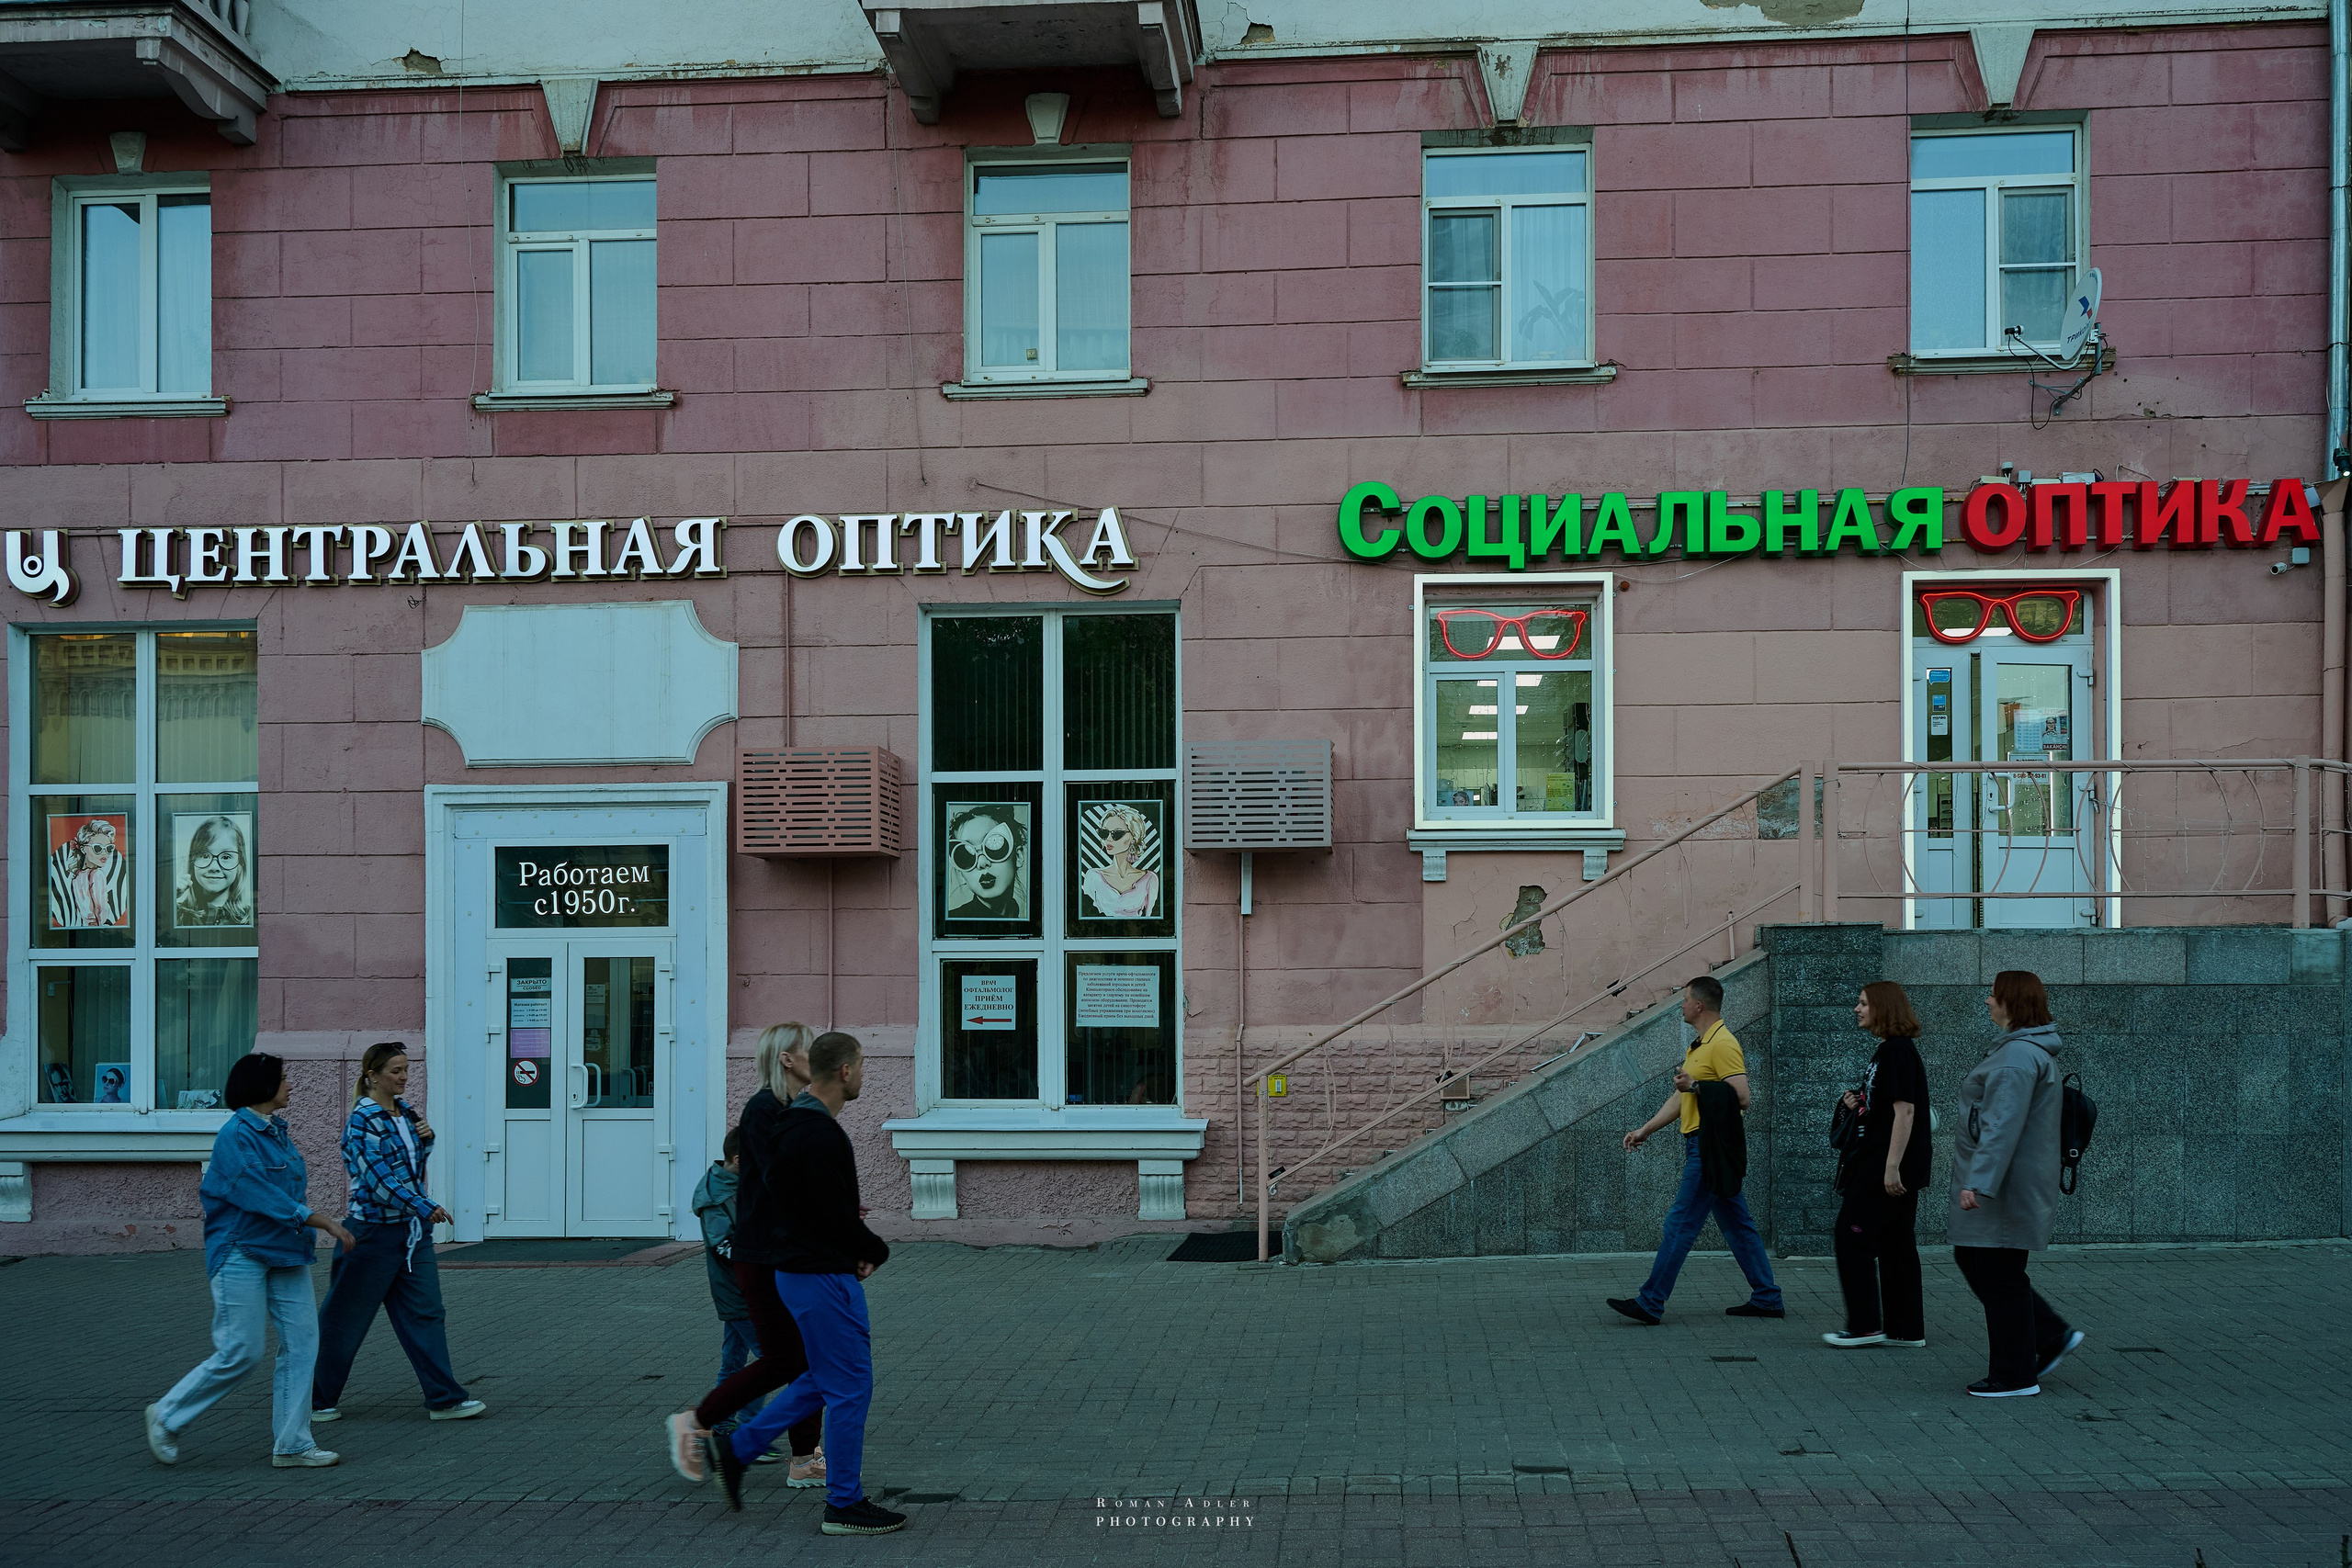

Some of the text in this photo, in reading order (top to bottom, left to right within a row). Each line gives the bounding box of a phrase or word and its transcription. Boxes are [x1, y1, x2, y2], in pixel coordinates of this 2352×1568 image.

[117, 516, 725, 596] ЦЕНТРАЛЬНАЯ
[776, 507, 1139, 592] ОПТИКА
[1337, 478, 2321, 571] СОЦИАЛЬНАЯ ОПТИКА
[518, 861, 650, 886] Работаем
[975, 994, 1003, 1002] ПРИЁМ
